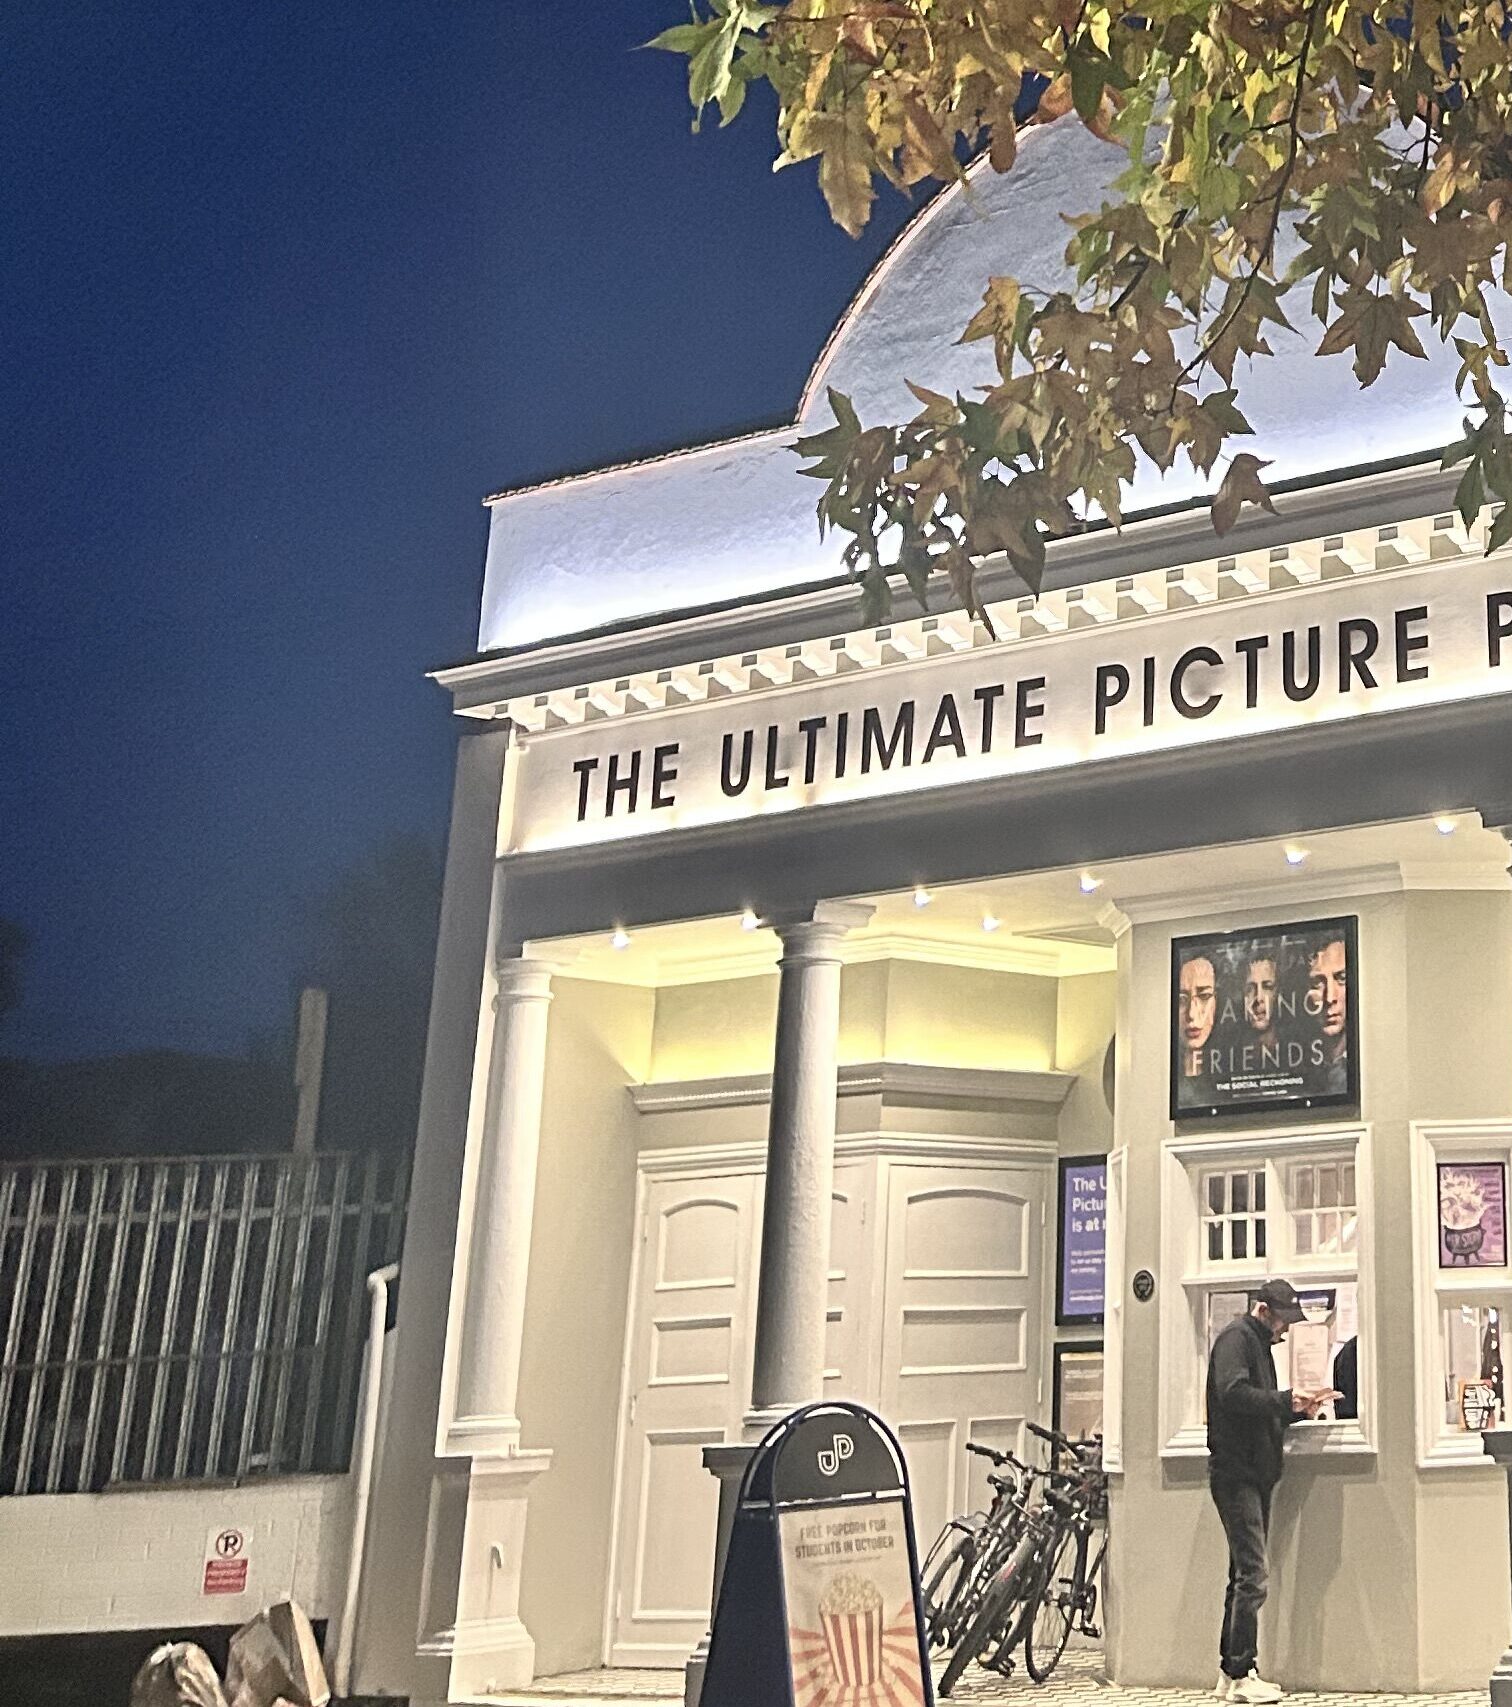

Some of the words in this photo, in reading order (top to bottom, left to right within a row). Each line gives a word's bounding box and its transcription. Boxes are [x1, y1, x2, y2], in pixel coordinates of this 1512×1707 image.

[573, 743, 680, 821] THE
[720, 677, 1046, 797] ULTIMATE
[1095, 605, 1430, 735] PICTURE
[1192, 1039, 1324, 1075] FRIENDS
[1072, 1177, 1096, 1193] The
[1085, 1217, 1100, 1231] at
